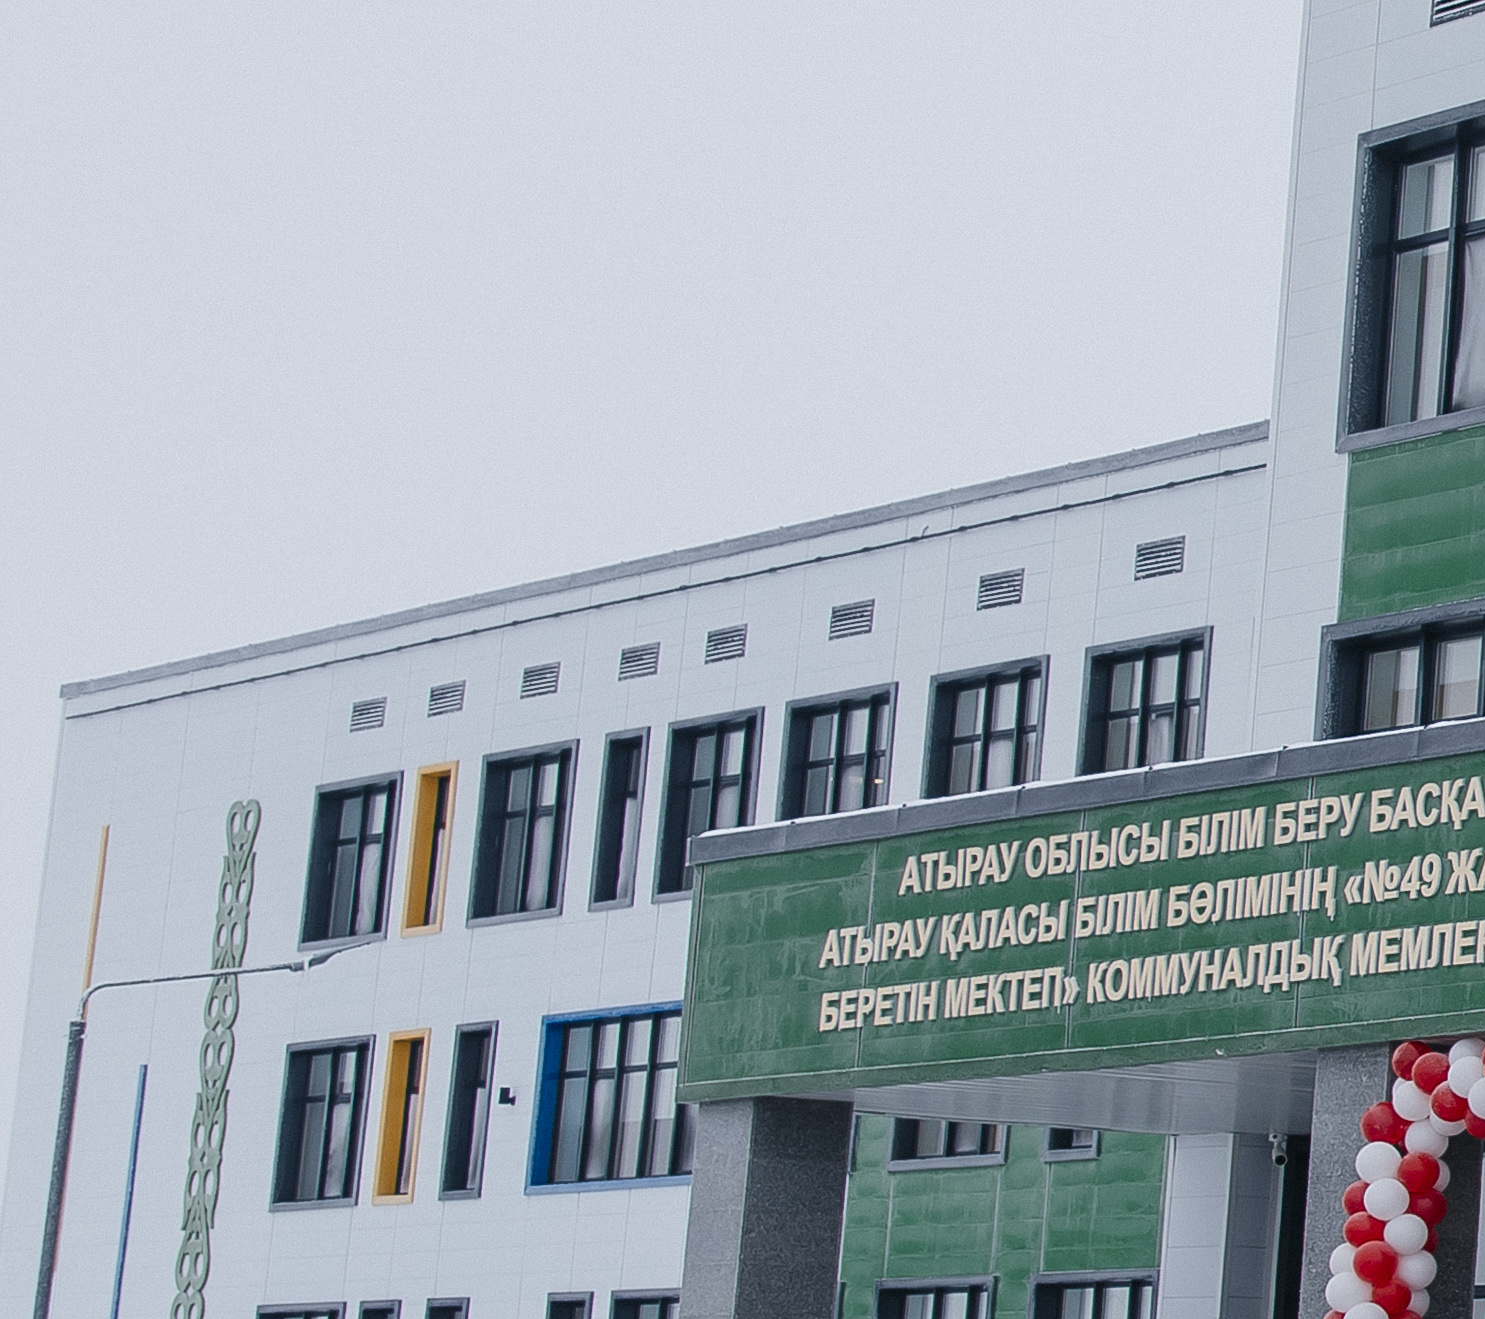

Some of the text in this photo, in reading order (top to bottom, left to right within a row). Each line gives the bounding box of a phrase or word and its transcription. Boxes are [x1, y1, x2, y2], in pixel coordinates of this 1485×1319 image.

[898, 850, 1017, 896] АТЫРАУ
[1024, 822, 1169, 878] ОБЛЫСЫ
[1176, 806, 1264, 859] БІЛІМ
[1273, 792, 1362, 846] БЕРУ
[818, 917, 935, 969] АТЫРАУ
[939, 900, 1067, 961] ҚАЛАСЫ
[1074, 888, 1159, 938] БІЛІМ
[1166, 866, 1335, 927] БӨЛІМІНІҢ
[1343, 853, 1440, 904] «№49
[818, 981, 937, 1032] БЕРЕТІН
[943, 967, 1077, 1019] МЕКТЕП»
[1086, 935, 1343, 1004] КОММУНАЛДЫҚ
